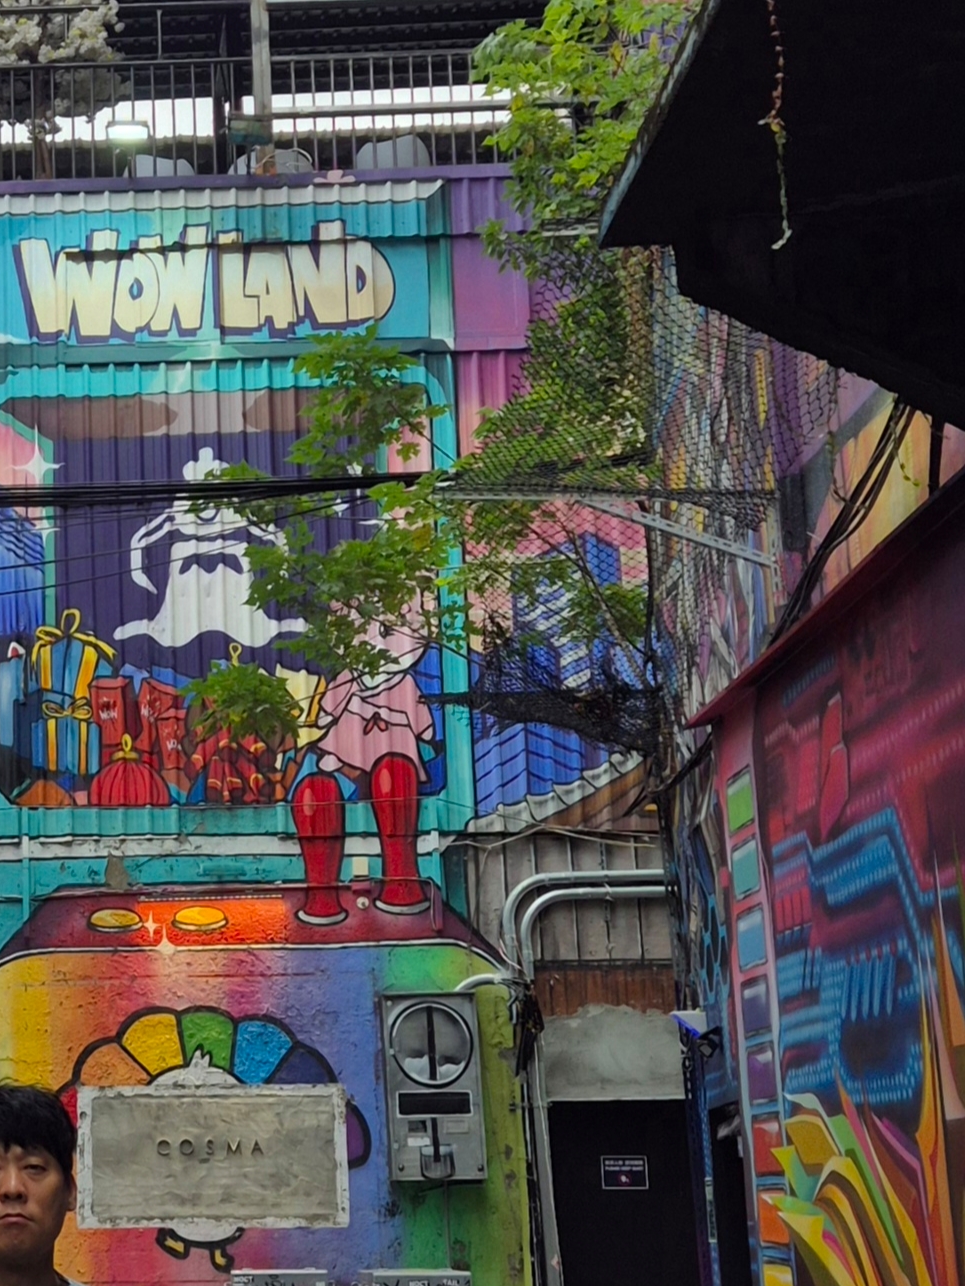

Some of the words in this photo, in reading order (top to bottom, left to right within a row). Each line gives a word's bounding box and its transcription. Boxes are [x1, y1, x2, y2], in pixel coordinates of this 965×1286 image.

[19, 223, 208, 341] WOW
[215, 221, 394, 336] LAND
[157, 1138, 264, 1156] COSMA
